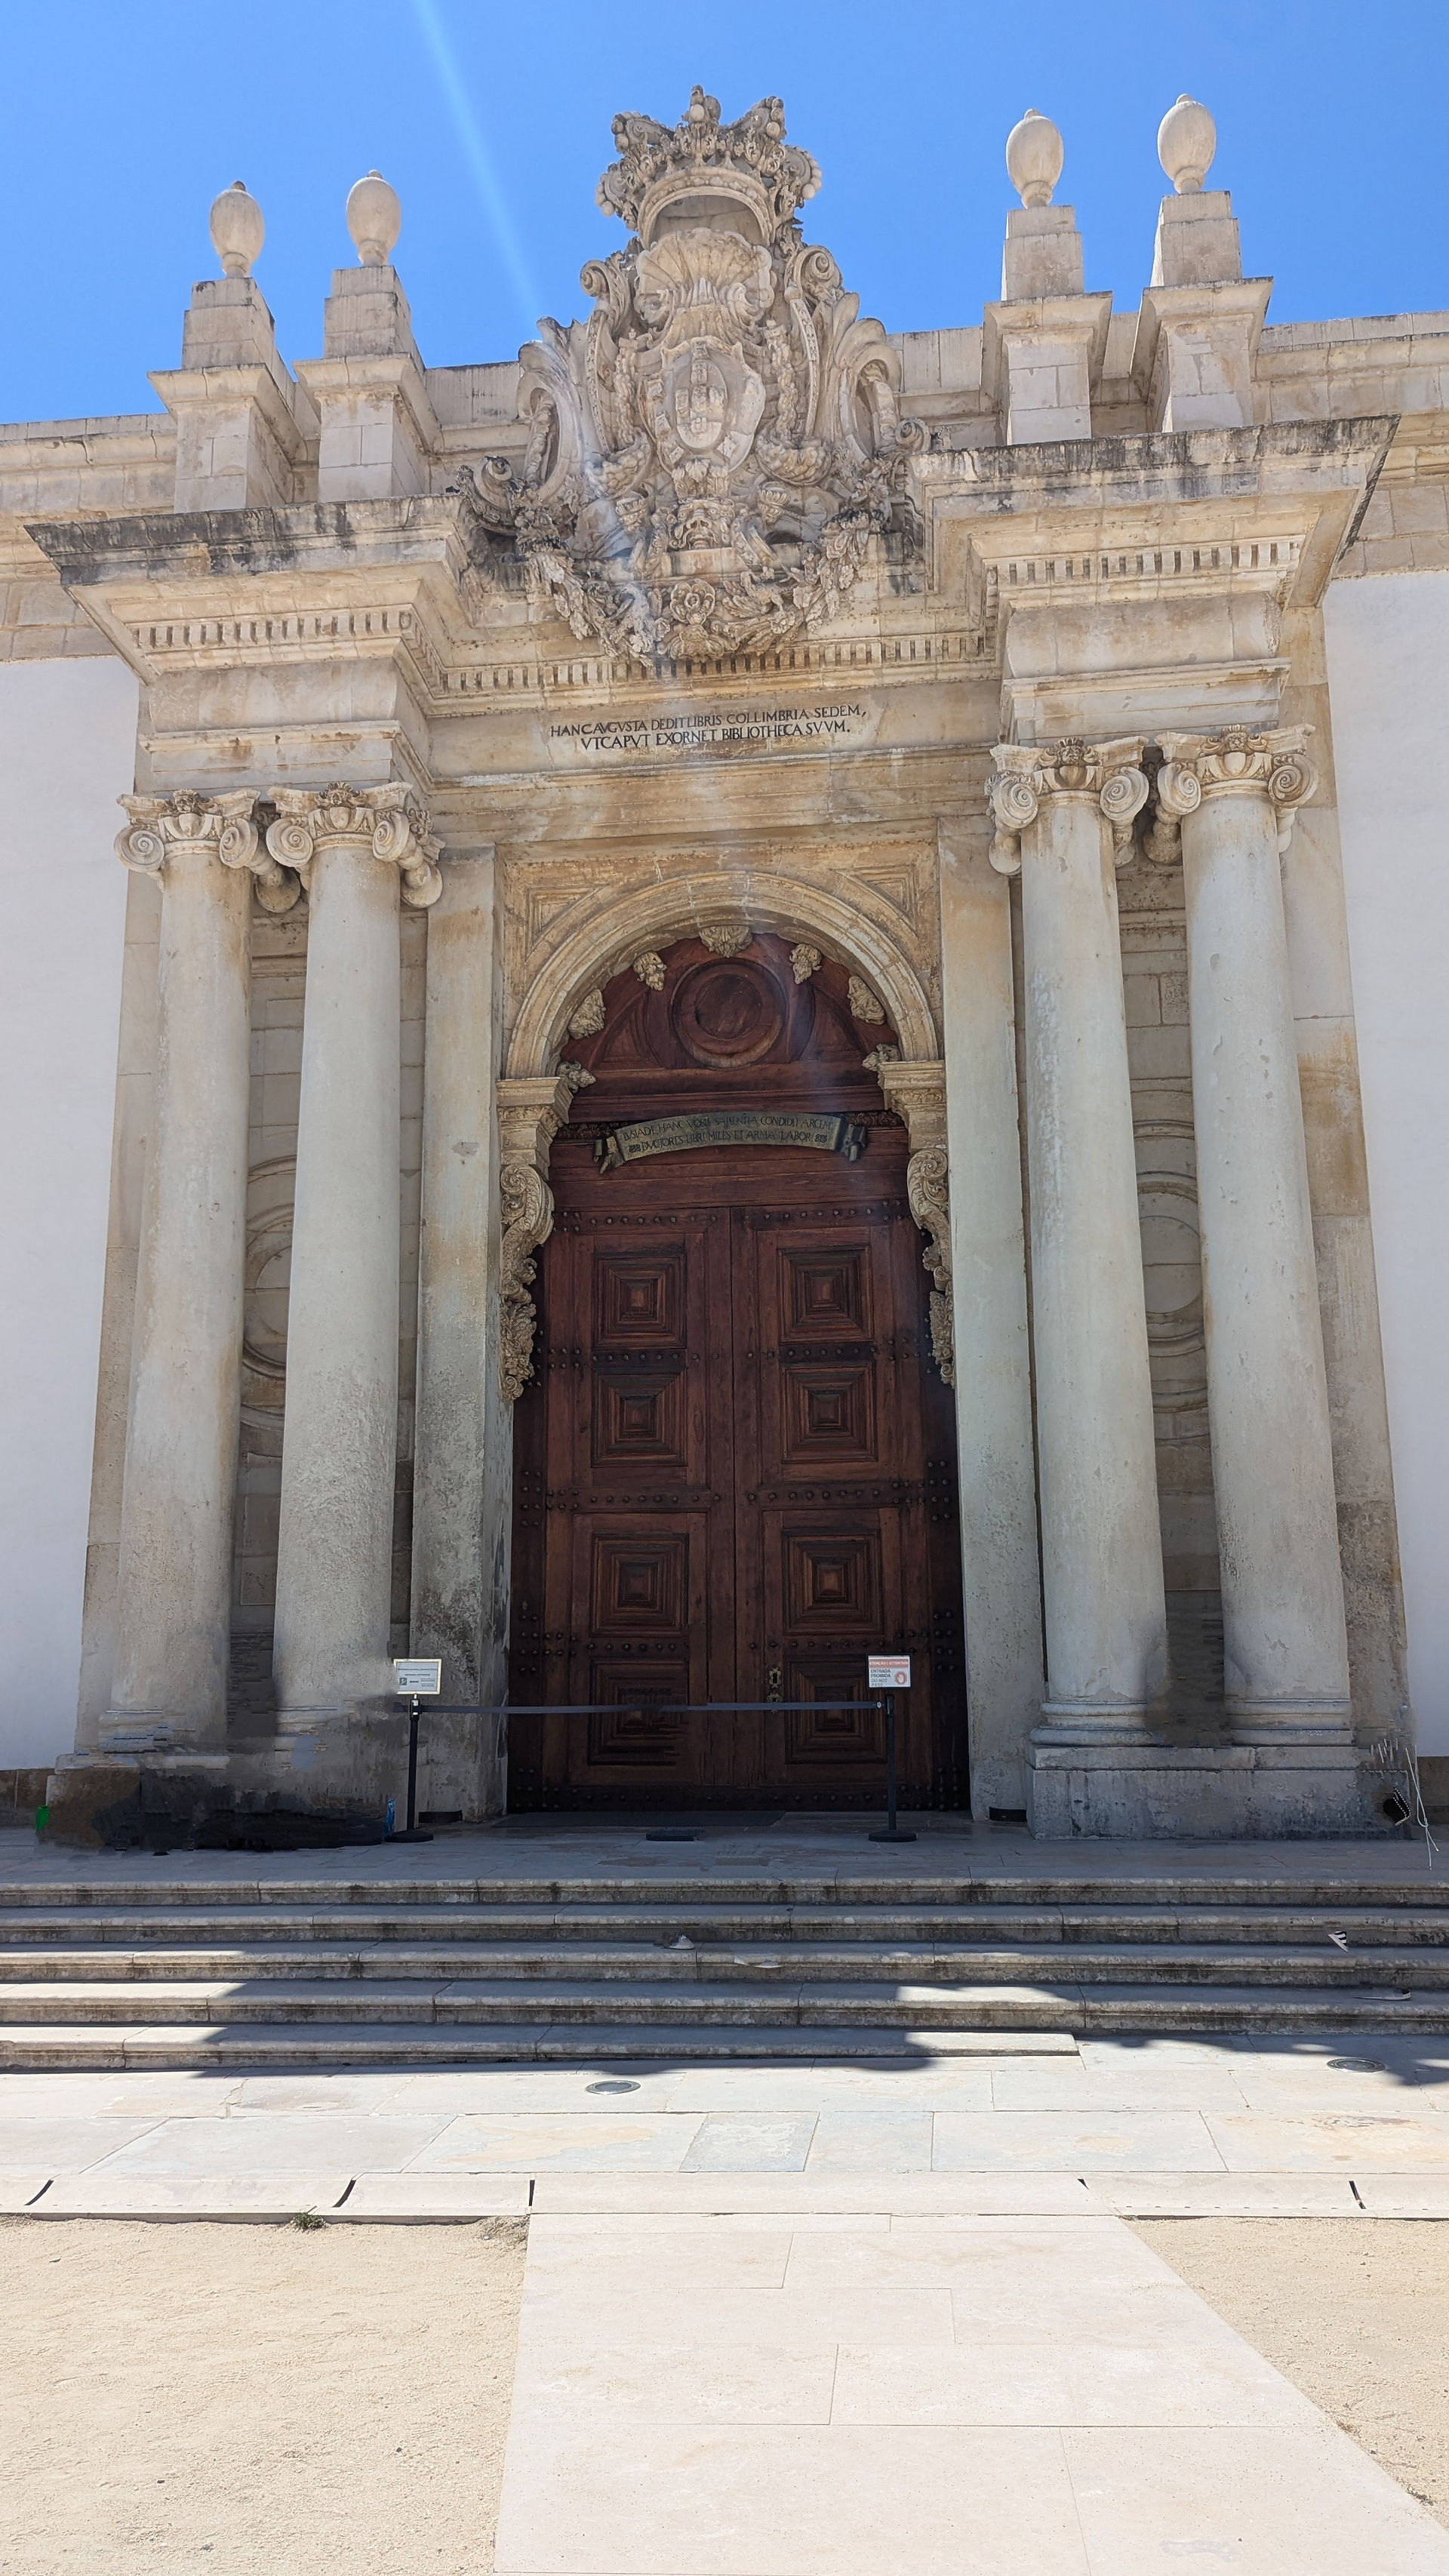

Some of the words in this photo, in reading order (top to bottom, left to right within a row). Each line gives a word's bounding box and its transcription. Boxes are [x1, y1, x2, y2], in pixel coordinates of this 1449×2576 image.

[727, 709, 811, 725] COLLIMBRIA
[814, 704, 866, 719] SEDEM,
[656, 729, 718, 746] EXORNET
[722, 723, 803, 740] BIBLIOTHECA
[805, 720, 851, 736] SVVM.
